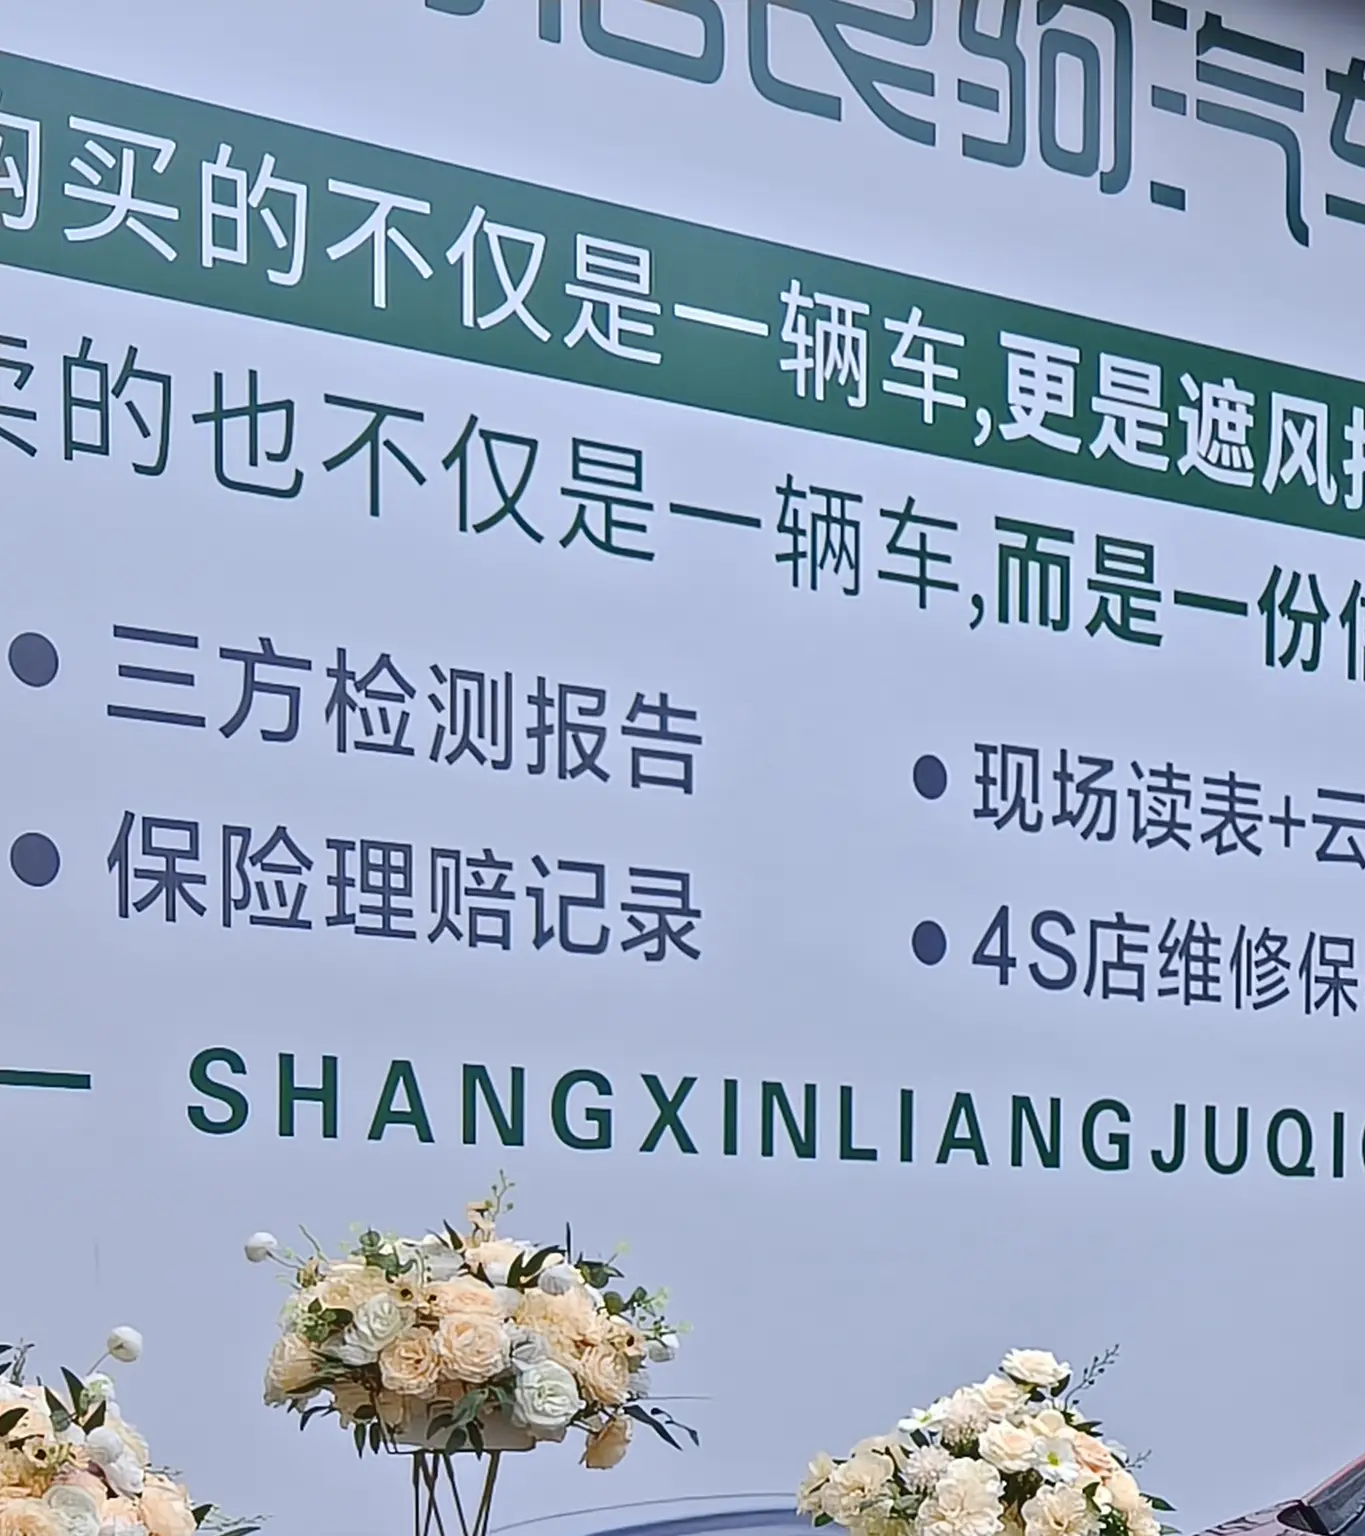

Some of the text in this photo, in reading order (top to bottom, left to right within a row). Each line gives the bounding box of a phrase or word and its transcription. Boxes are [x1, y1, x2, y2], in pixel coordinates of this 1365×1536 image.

[106, 623, 704, 796] 三方检测报告
[106, 809, 704, 963] 保险理赔记录
